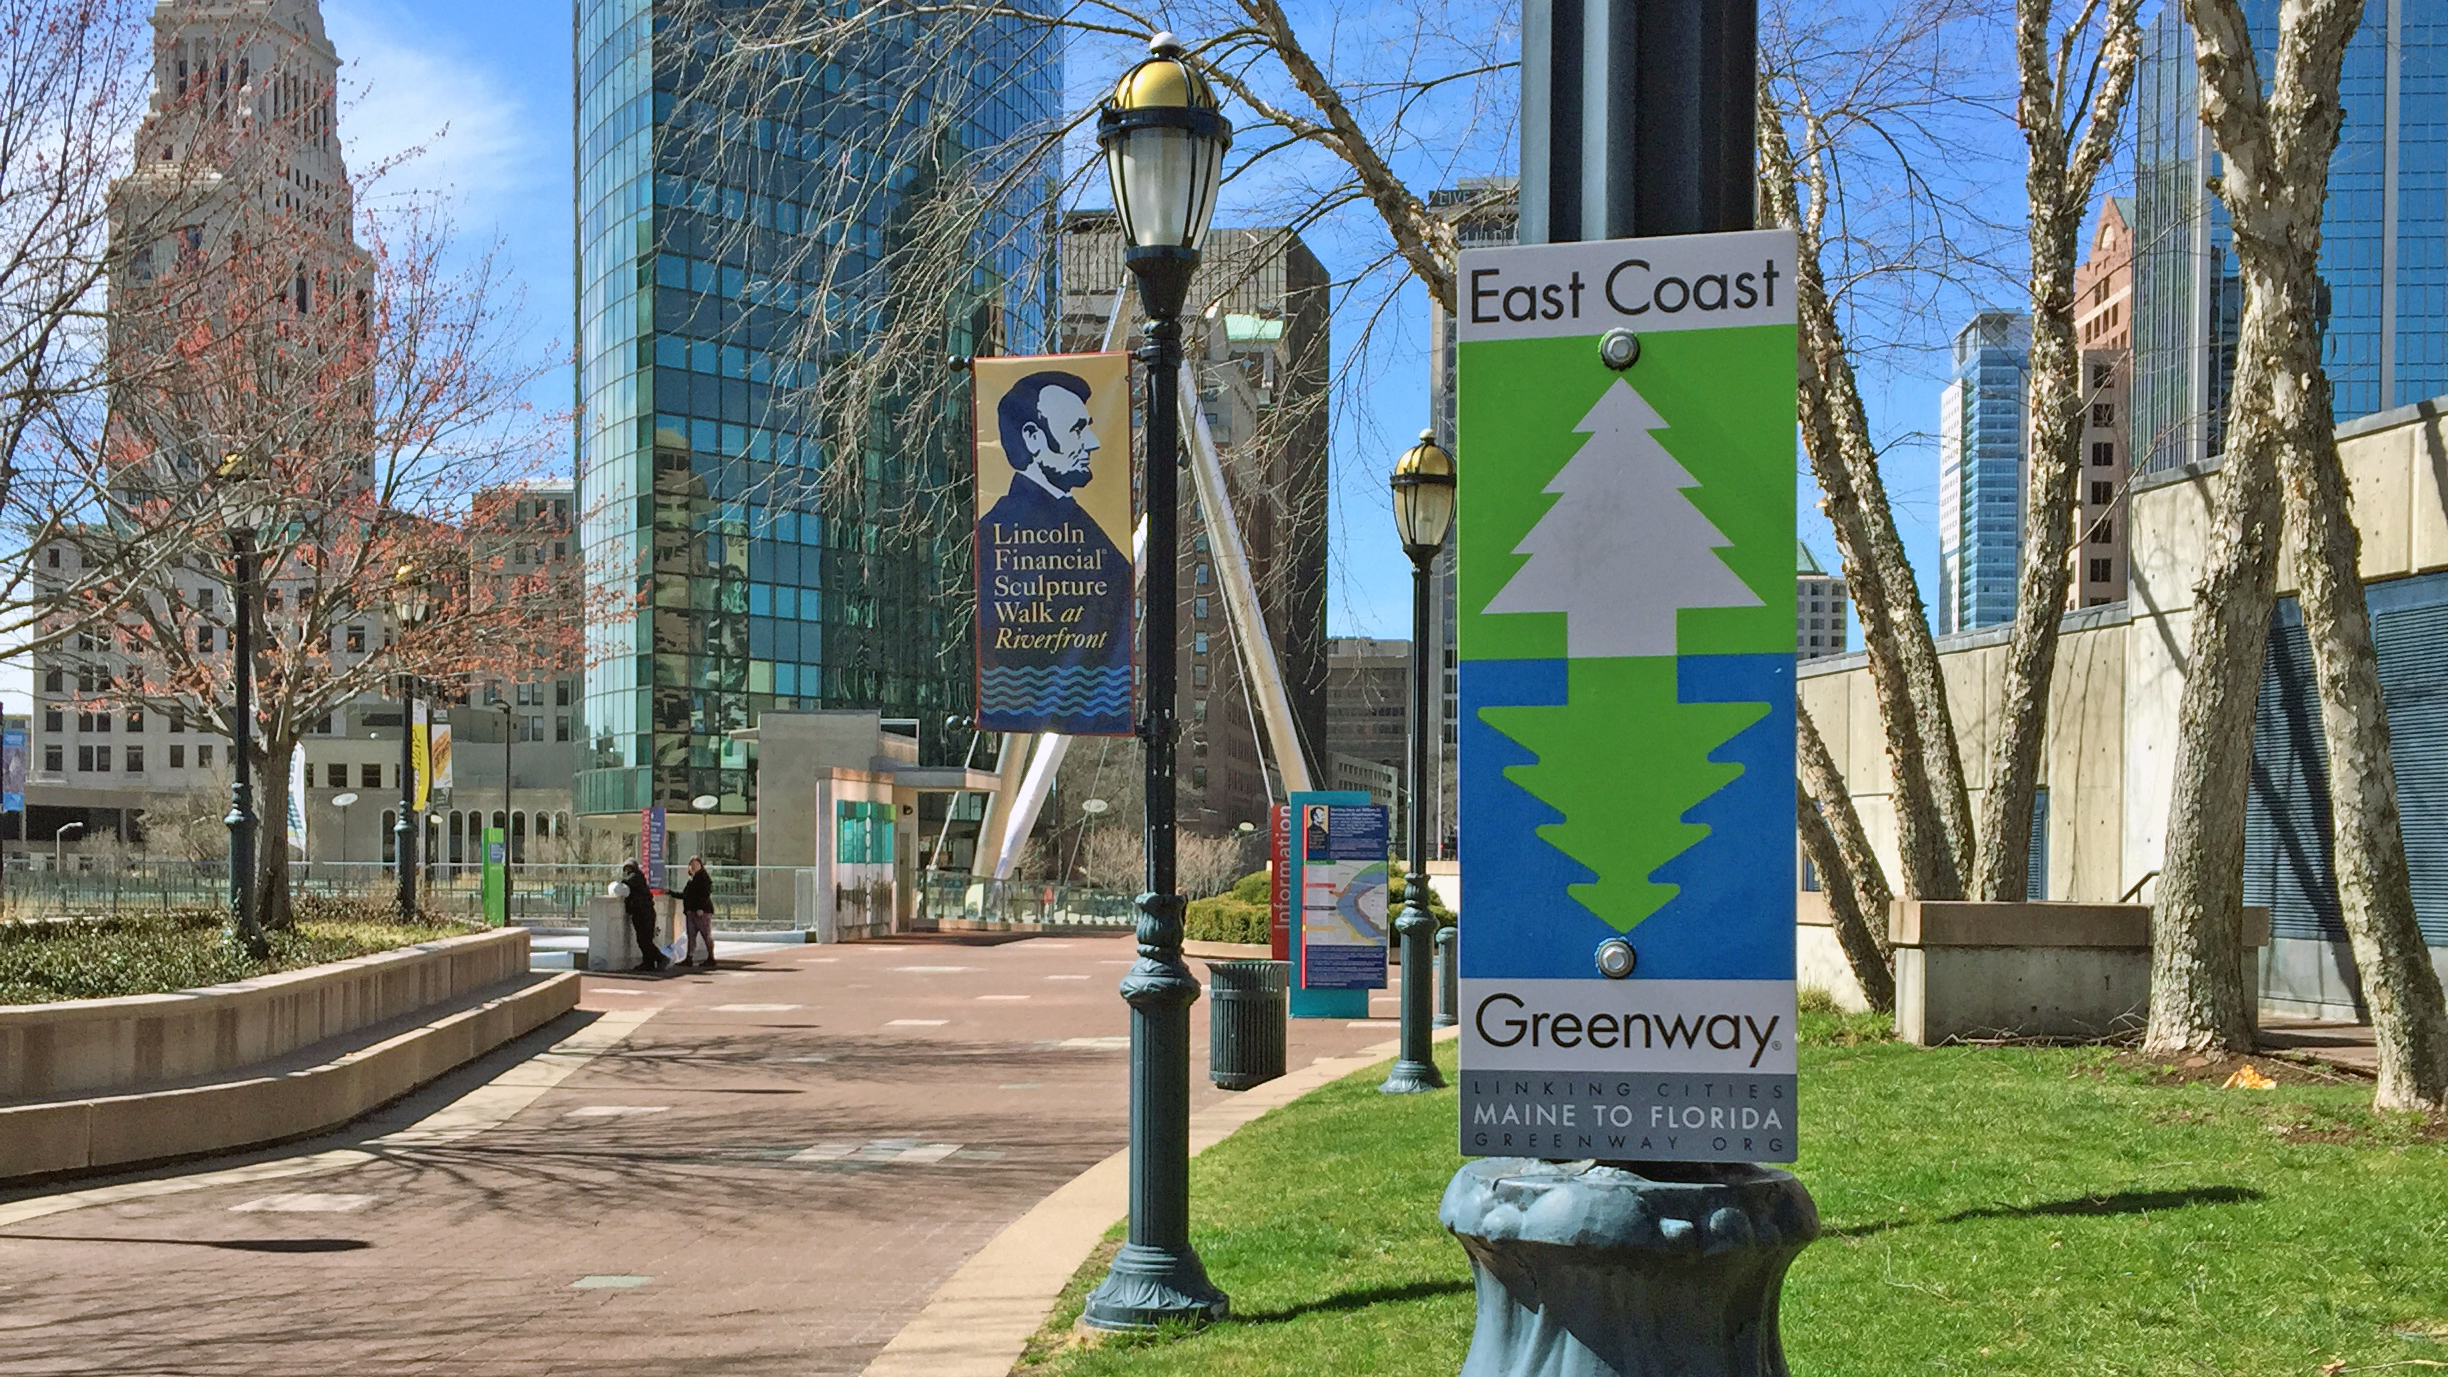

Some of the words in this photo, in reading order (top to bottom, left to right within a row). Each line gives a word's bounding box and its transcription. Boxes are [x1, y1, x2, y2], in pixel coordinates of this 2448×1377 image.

[1471, 268, 1585, 323] East
[1605, 259, 1780, 315] Coast
[994, 522, 1085, 545] Lincoln
[994, 574, 1108, 601] Sculpture
[994, 602, 1054, 623] Walk
[1060, 605, 1084, 623] at
[994, 627, 1108, 653] Riverfront
[1274, 806, 1291, 929] Information
[1474, 1081, 1631, 1097] LINKING
[1657, 1083, 1783, 1099] CITIES
[1473, 1104, 1576, 1126] MAINE
[1593, 1105, 1633, 1127] TO
[1651, 1106, 1783, 1130] FLORIDA
[1475, 1133, 1678, 1150] GREENWAY
[1711, 1137, 1783, 1152] ORG
